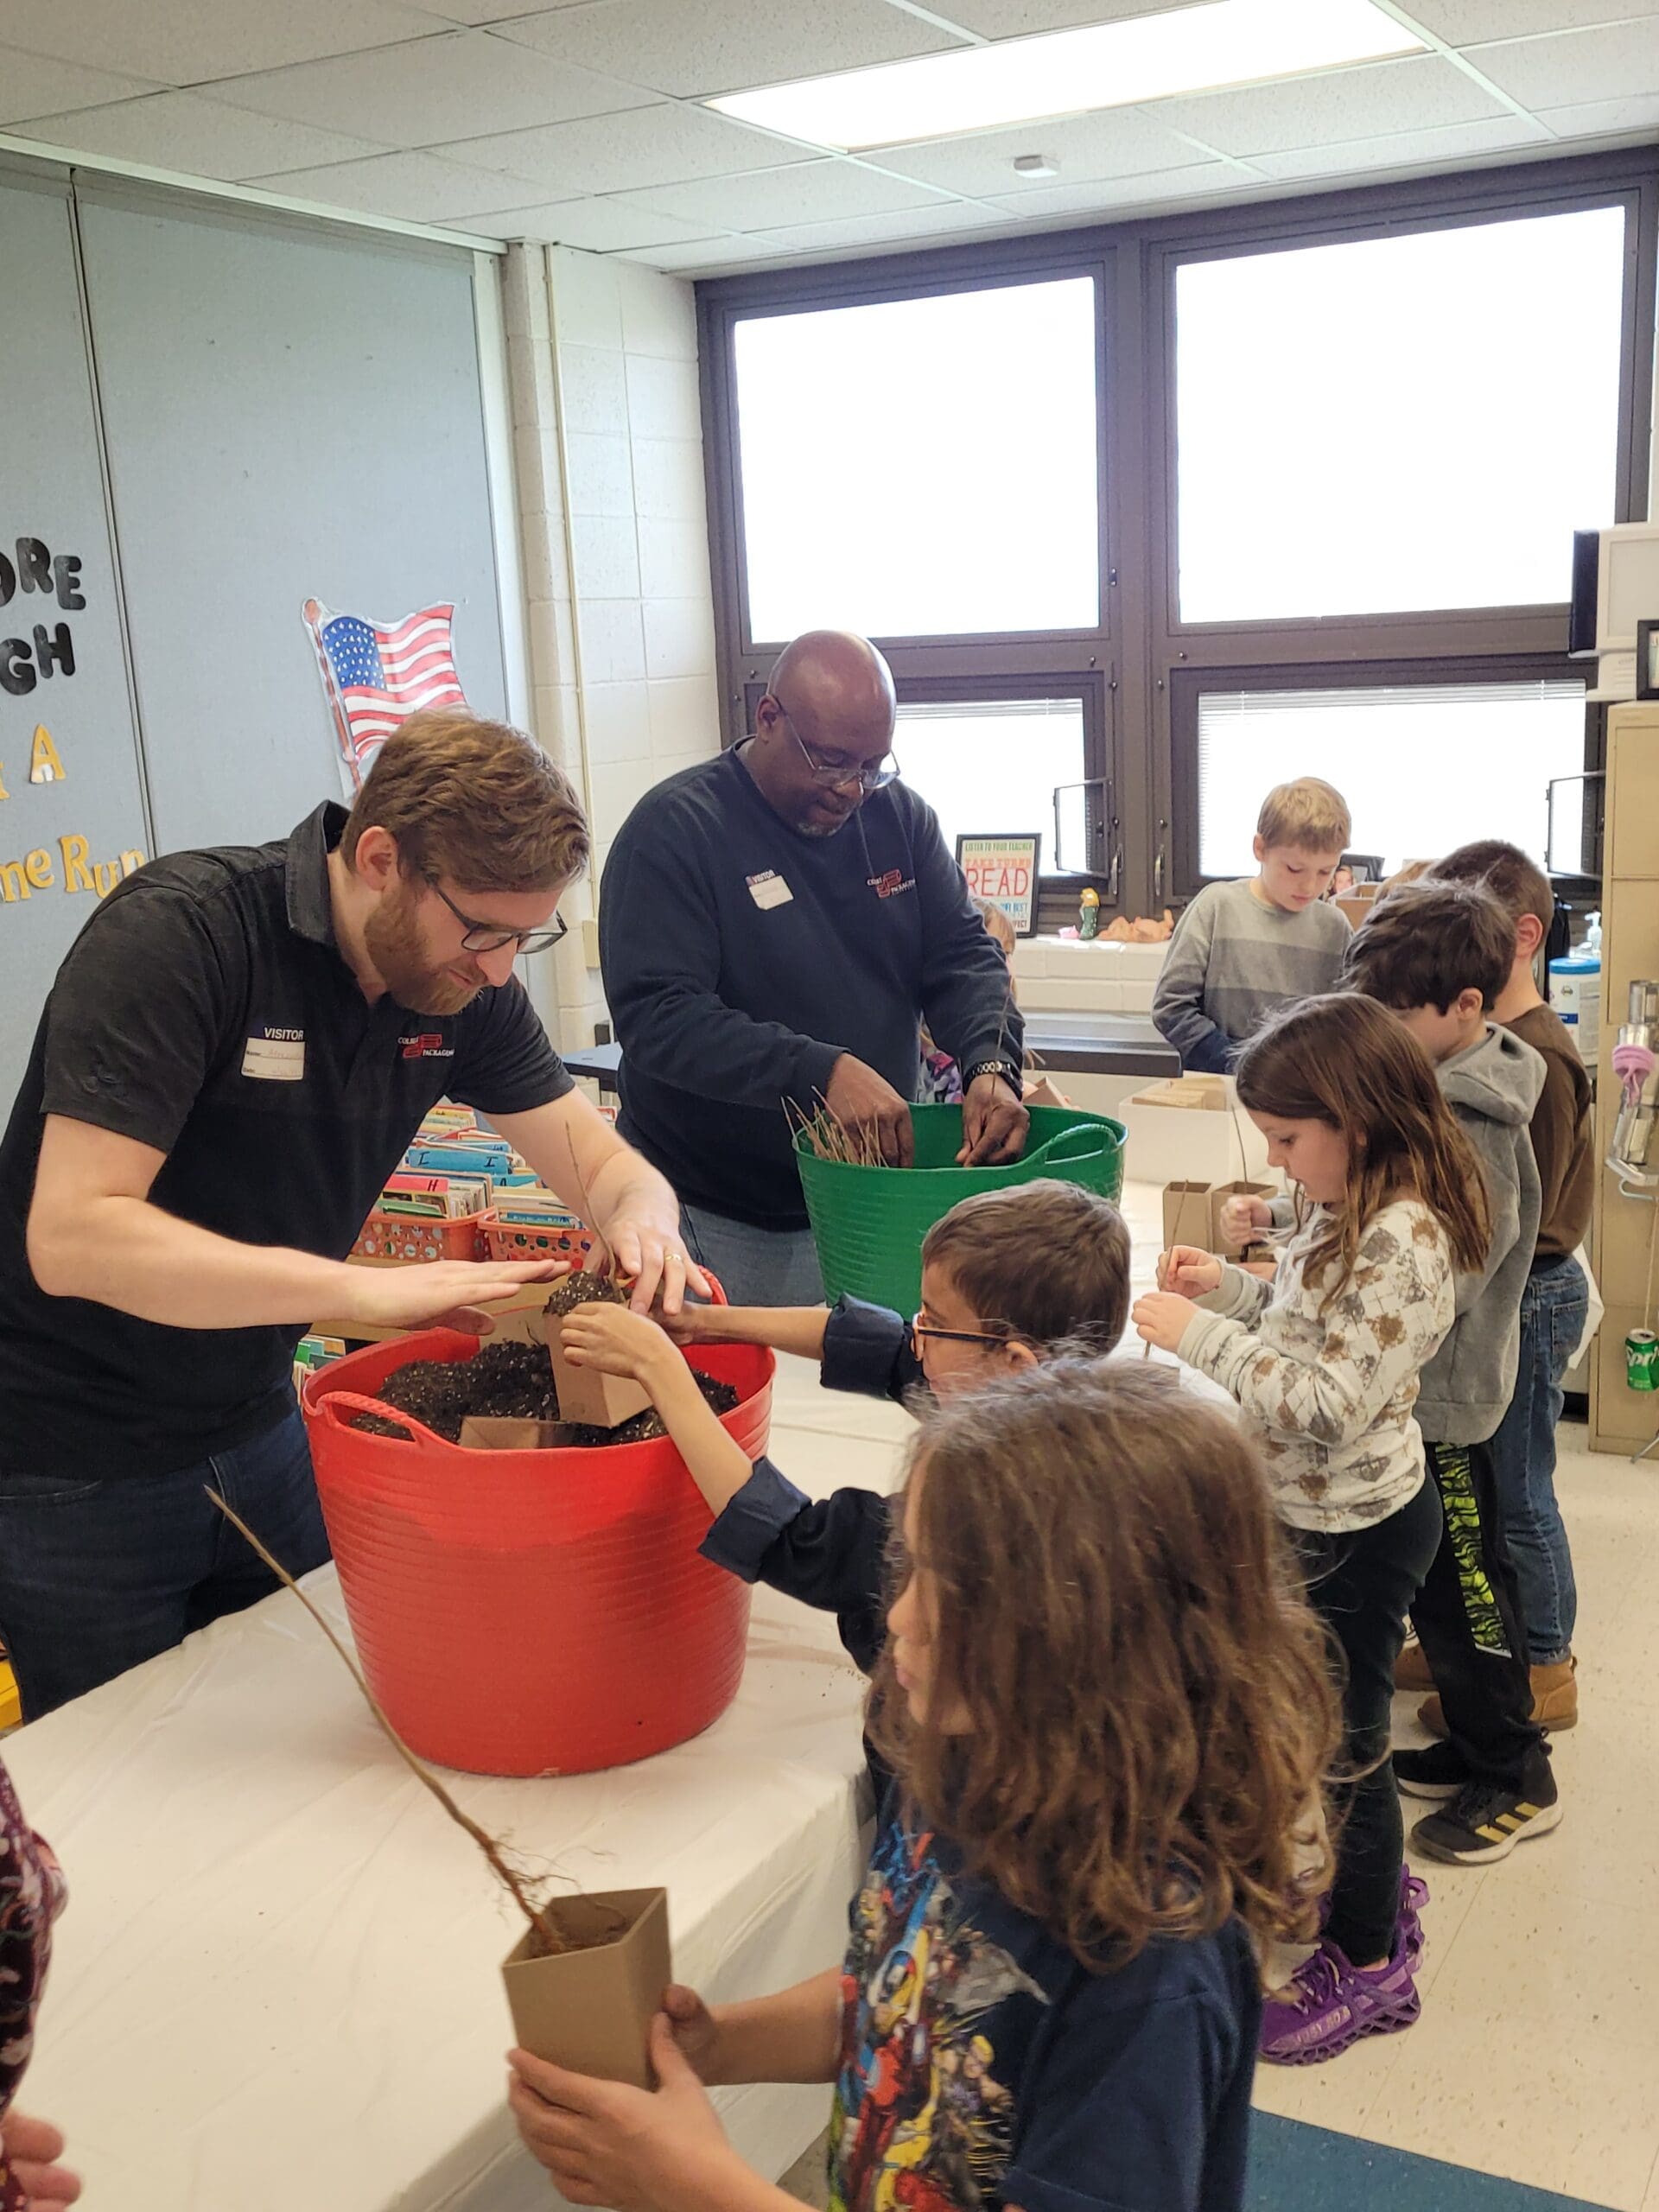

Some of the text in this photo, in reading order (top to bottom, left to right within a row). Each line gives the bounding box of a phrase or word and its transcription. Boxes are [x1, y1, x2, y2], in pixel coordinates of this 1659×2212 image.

[30, 724, 67, 784] A
[59, 834, 145, 899] Run
[966, 868, 1029, 897] READ
[264, 1027, 304, 1041] VISITOR
[427, 1179, 439, 1192] H
